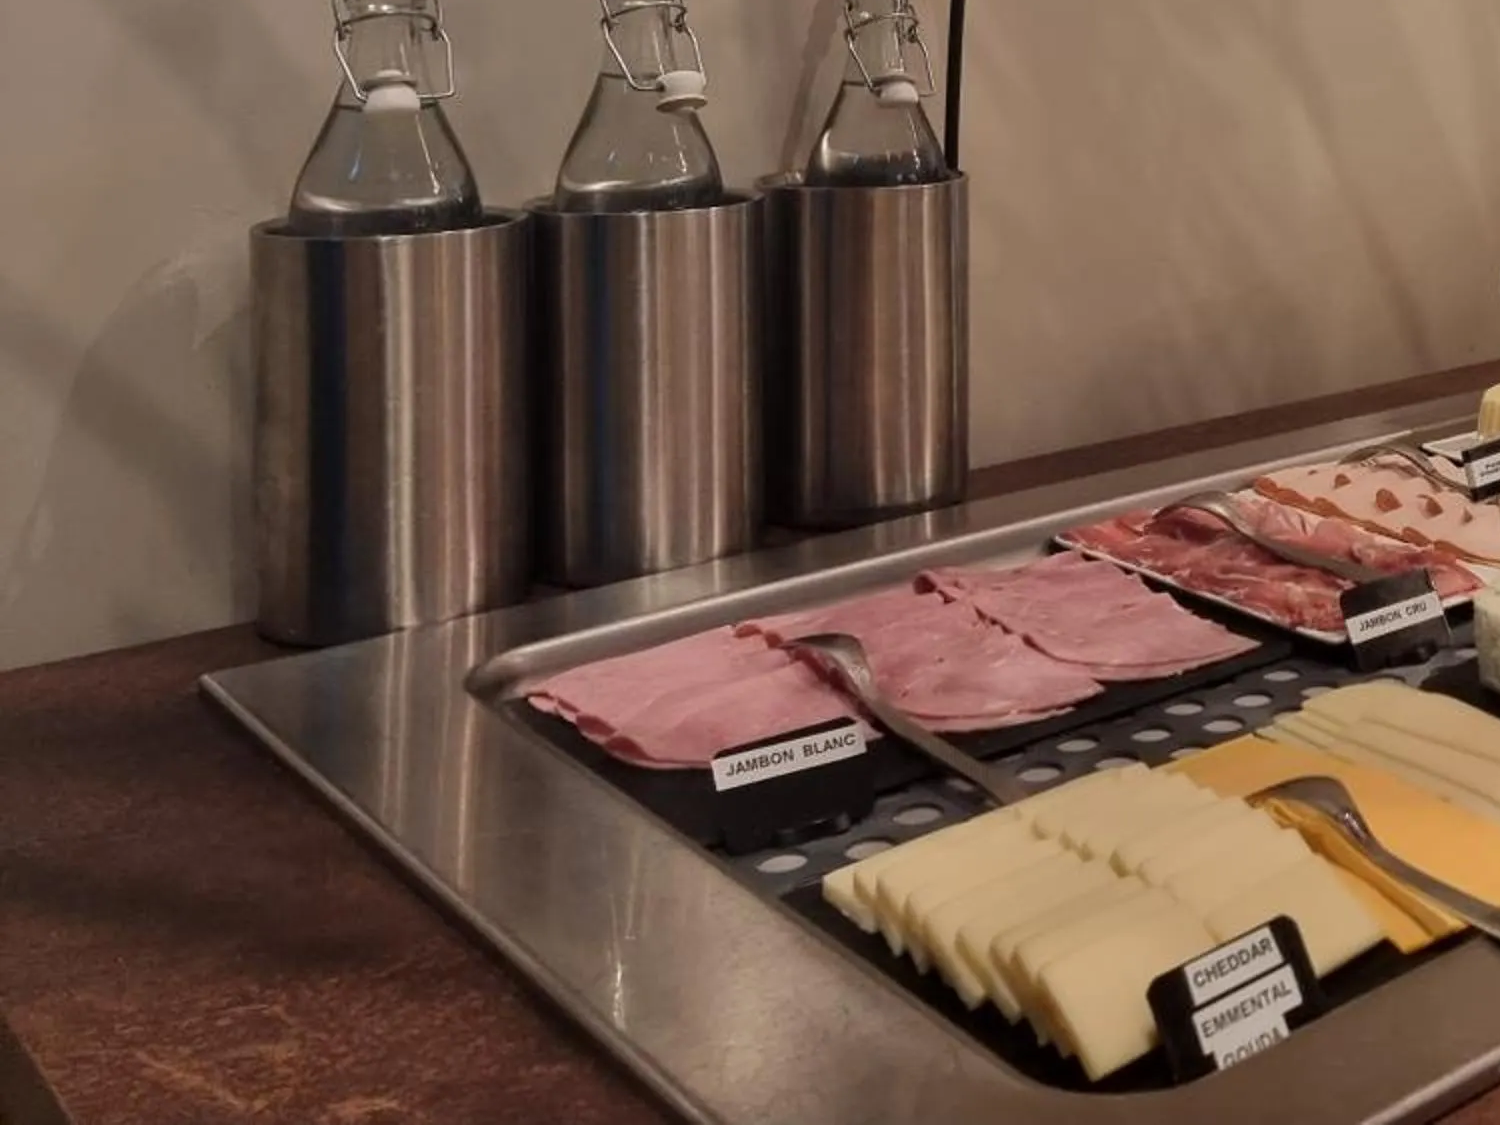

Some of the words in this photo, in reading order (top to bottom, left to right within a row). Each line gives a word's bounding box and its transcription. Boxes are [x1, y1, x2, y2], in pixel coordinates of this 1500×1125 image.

[1359, 609, 1402, 632] JAMBON
[1405, 602, 1427, 616] CRU
[725, 748, 795, 777] JAMBON
[802, 732, 857, 758] BLANC
[1193, 937, 1274, 989] CHEDDAR
[1201, 980, 1293, 1039] EMMENTAL
